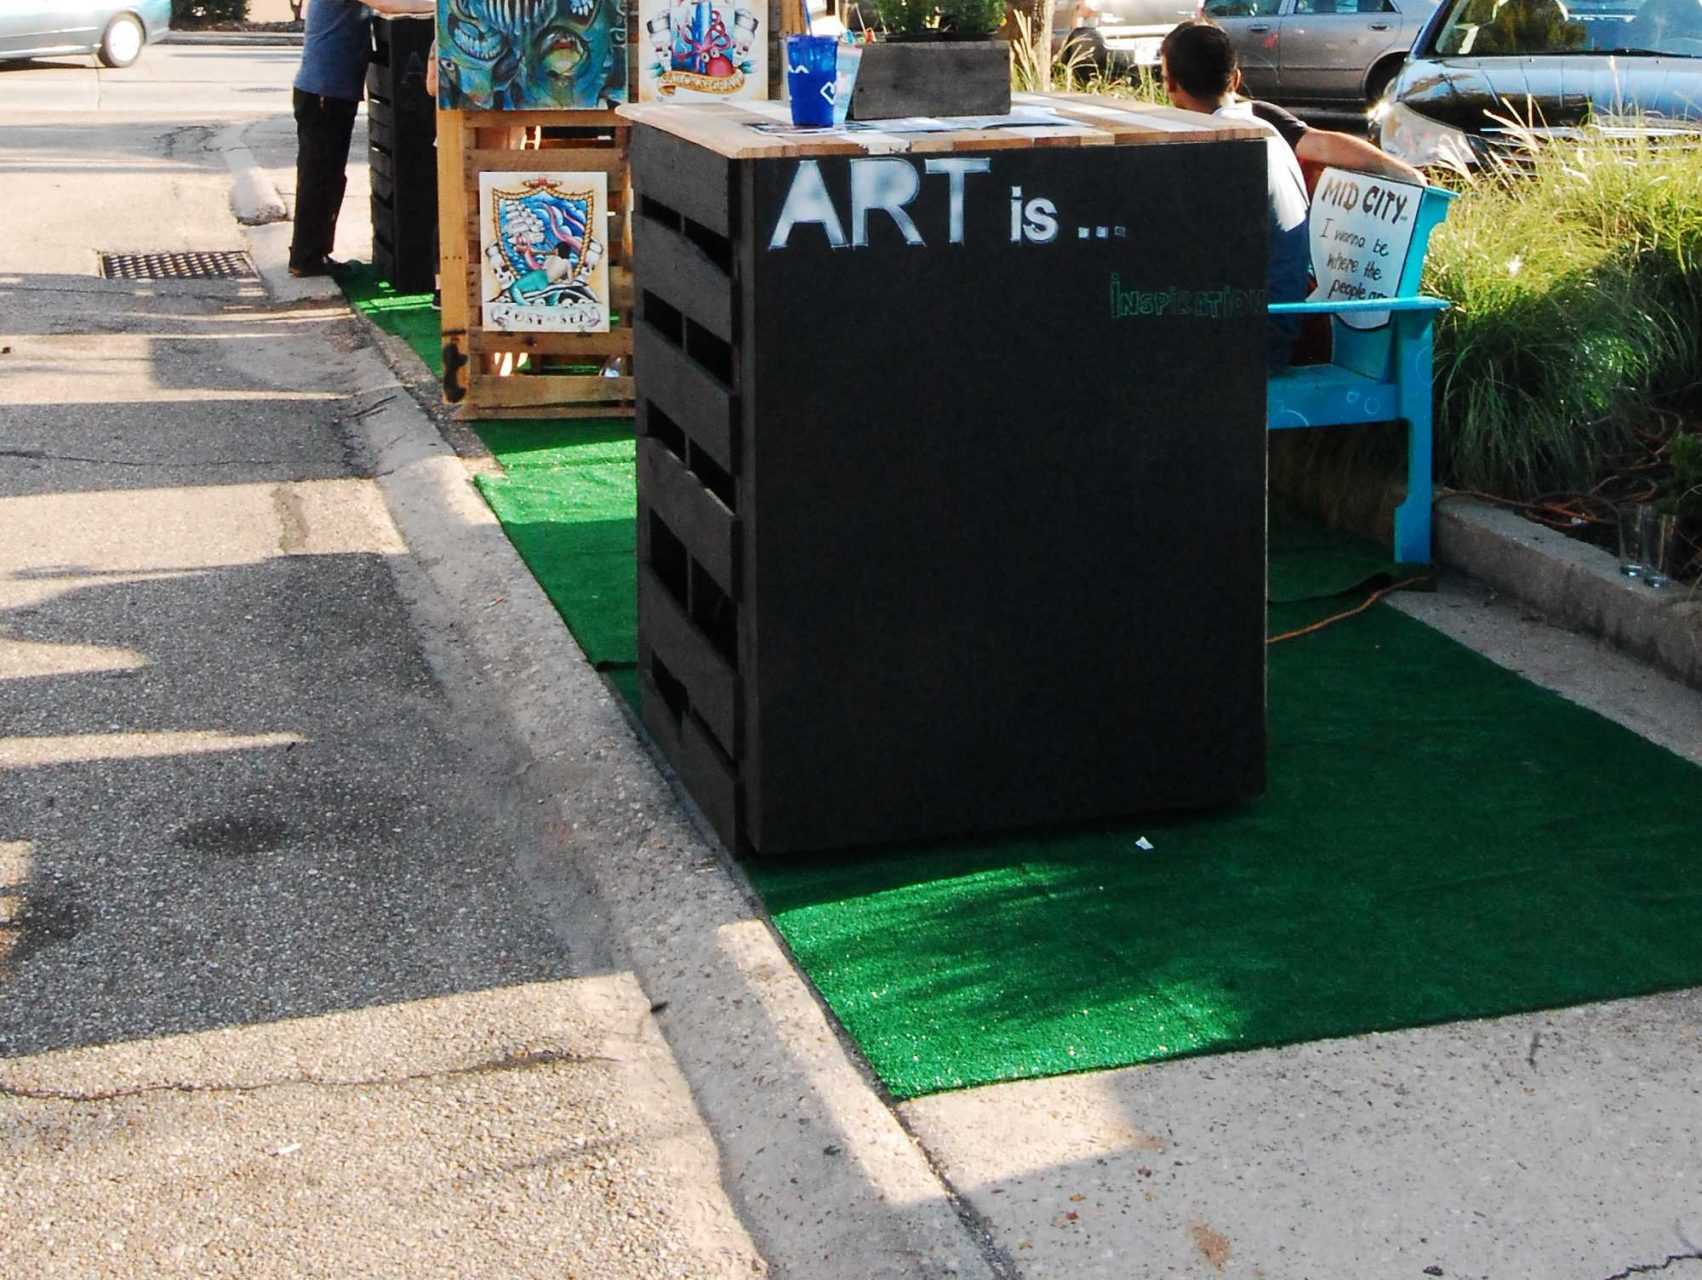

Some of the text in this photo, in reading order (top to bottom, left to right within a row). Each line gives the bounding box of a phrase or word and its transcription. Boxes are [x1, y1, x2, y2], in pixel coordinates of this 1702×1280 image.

[767, 157, 991, 250] ART
[1322, 177, 1408, 225] MID CITY
[1320, 217, 1335, 238] I
[1373, 238, 1389, 257] be
[1327, 252, 1382, 281] where the
[1328, 279, 1366, 299] people
